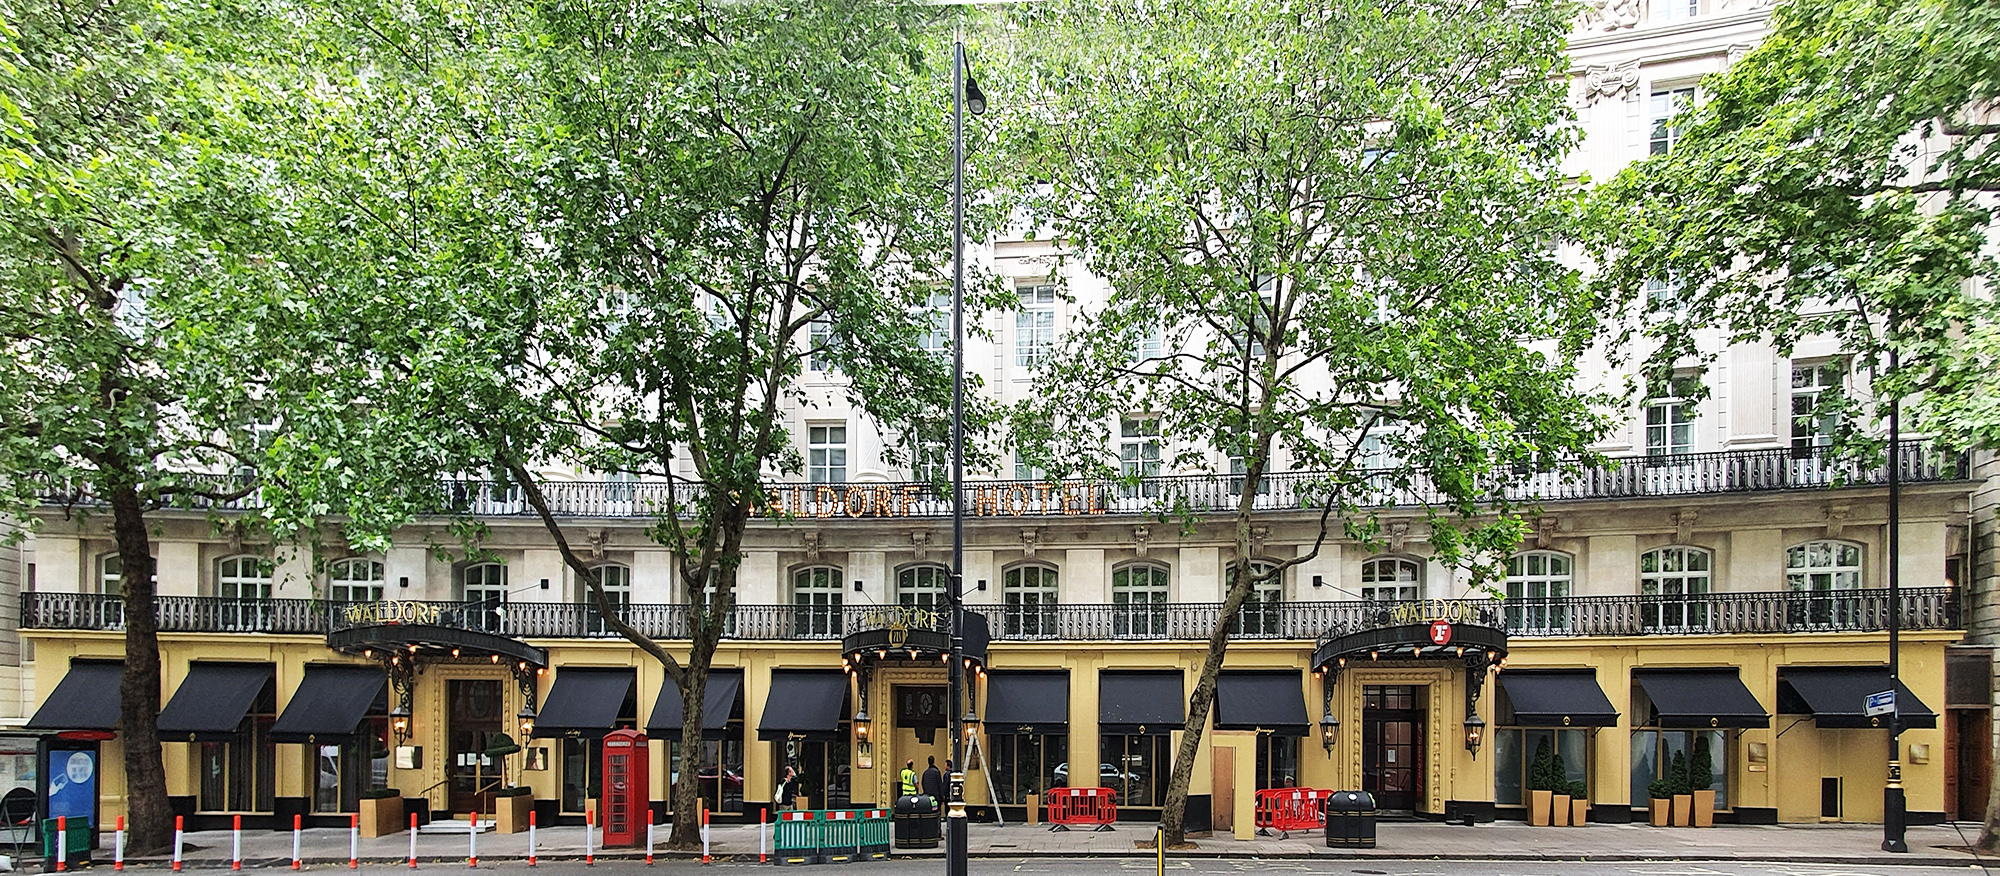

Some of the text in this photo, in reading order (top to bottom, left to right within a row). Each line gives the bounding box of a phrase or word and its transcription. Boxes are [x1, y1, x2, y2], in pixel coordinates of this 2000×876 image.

[731, 482, 1106, 518] ALDORF HOTEL
[346, 599, 440, 624] WALDORF
[864, 605, 939, 629] WALDORF
[1392, 597, 1480, 623] WALDORF
